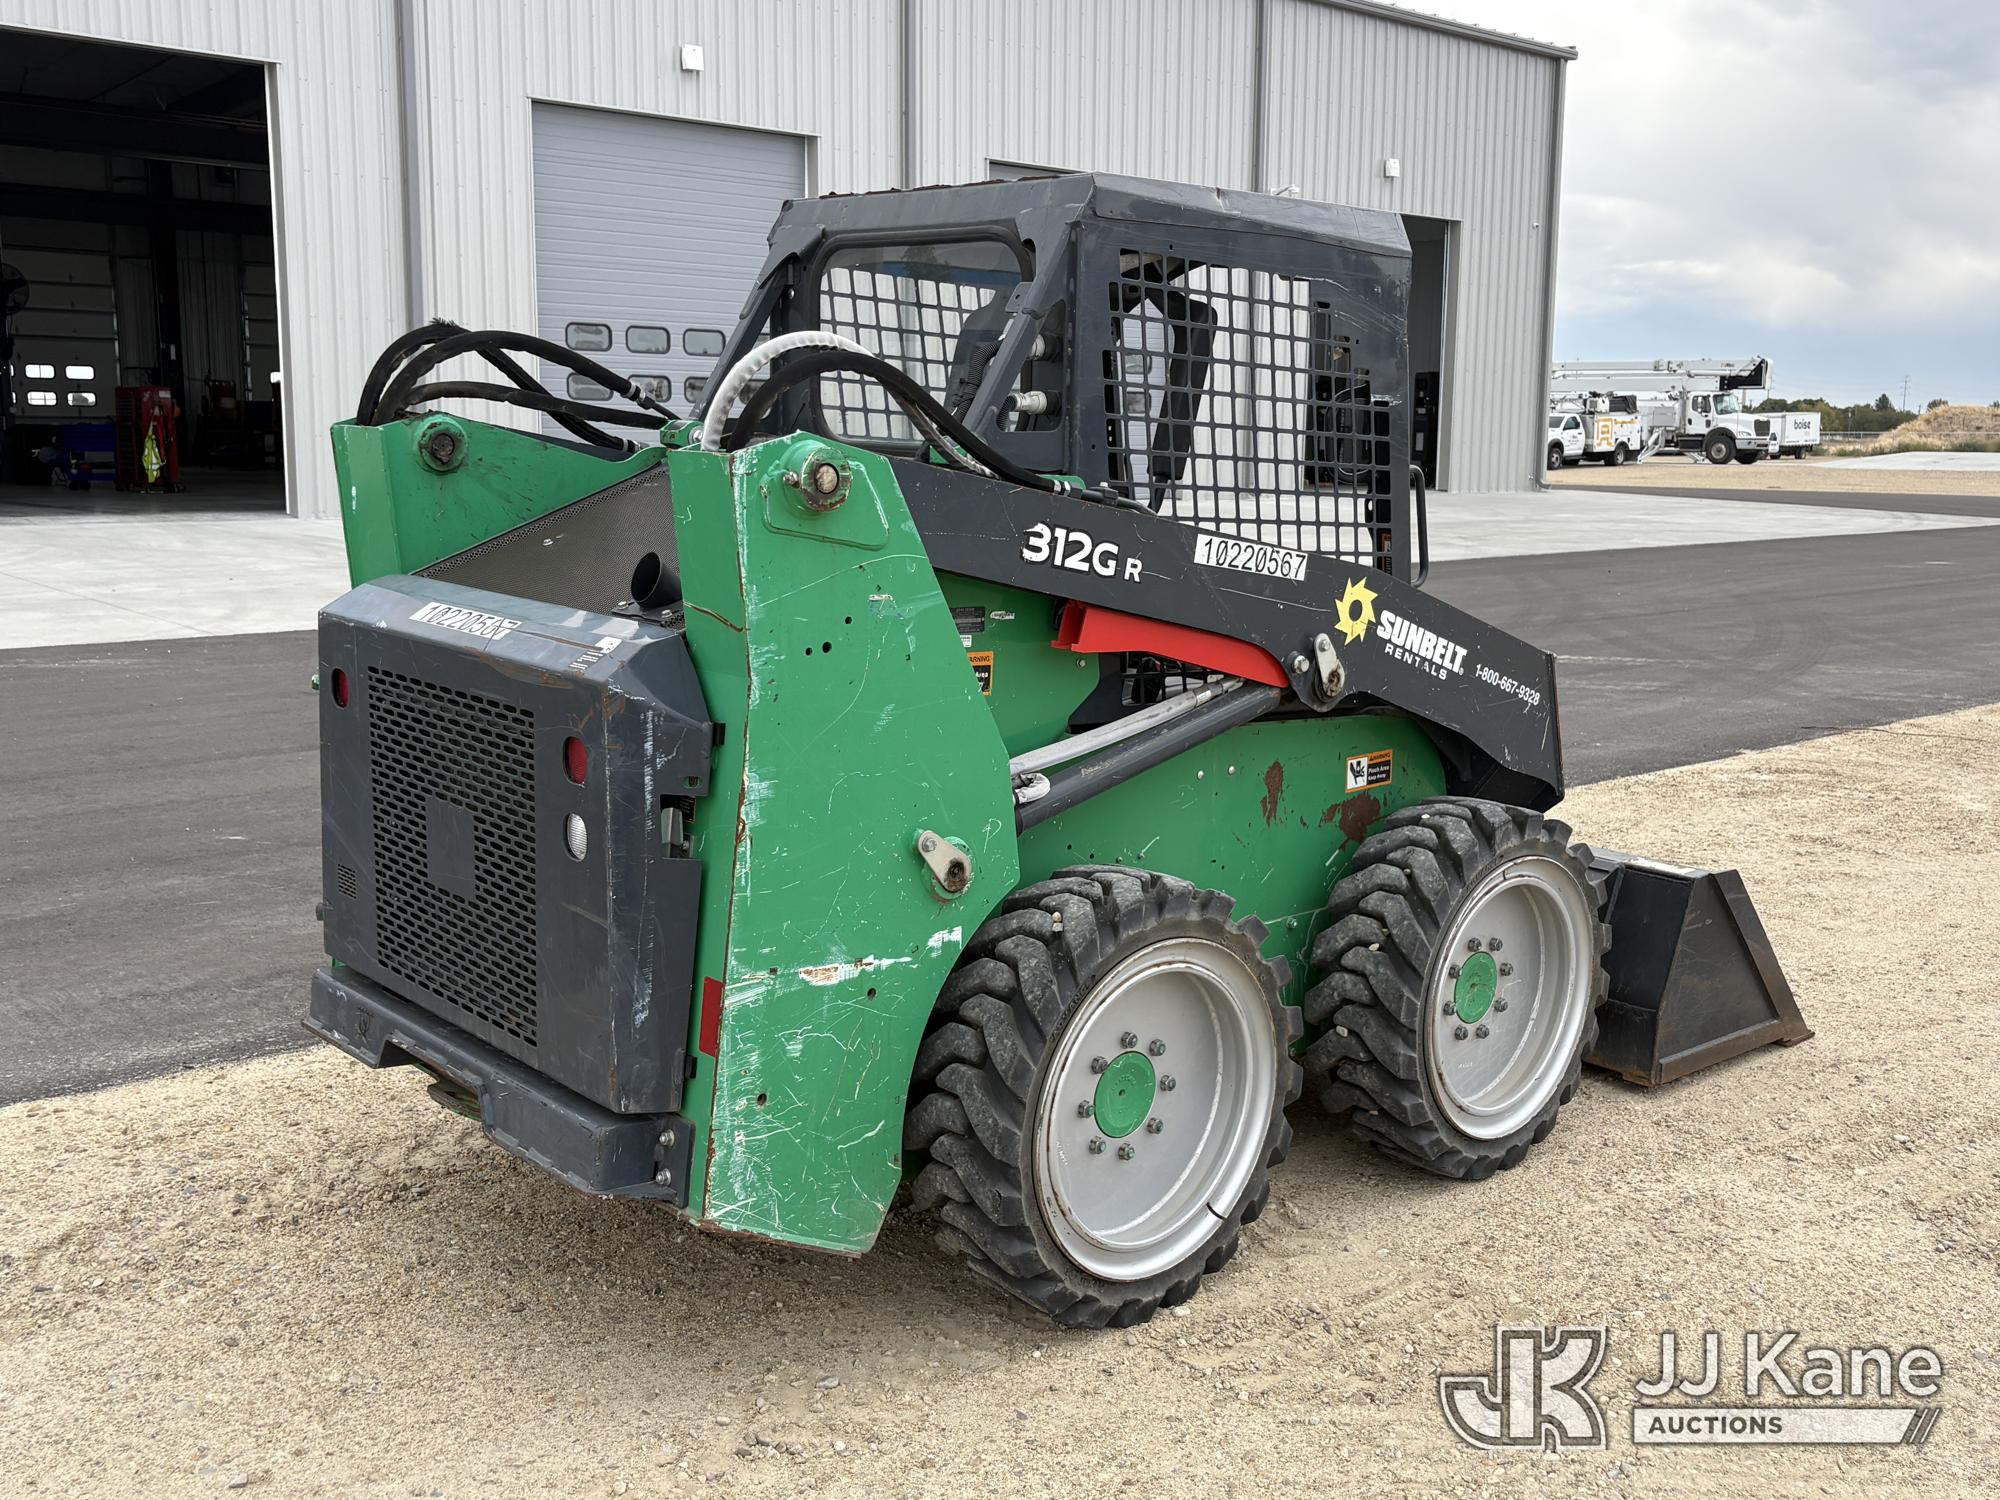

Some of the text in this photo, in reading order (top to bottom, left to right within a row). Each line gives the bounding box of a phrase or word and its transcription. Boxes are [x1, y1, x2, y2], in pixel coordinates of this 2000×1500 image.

[1793, 418, 1811, 430] boise
[1021, 522, 1143, 582] 312G R
[1203, 536, 1307, 581] 10220567
[1384, 644, 1448, 681] RENTALS
[1475, 663, 1540, 706] 1-800-667-9328
